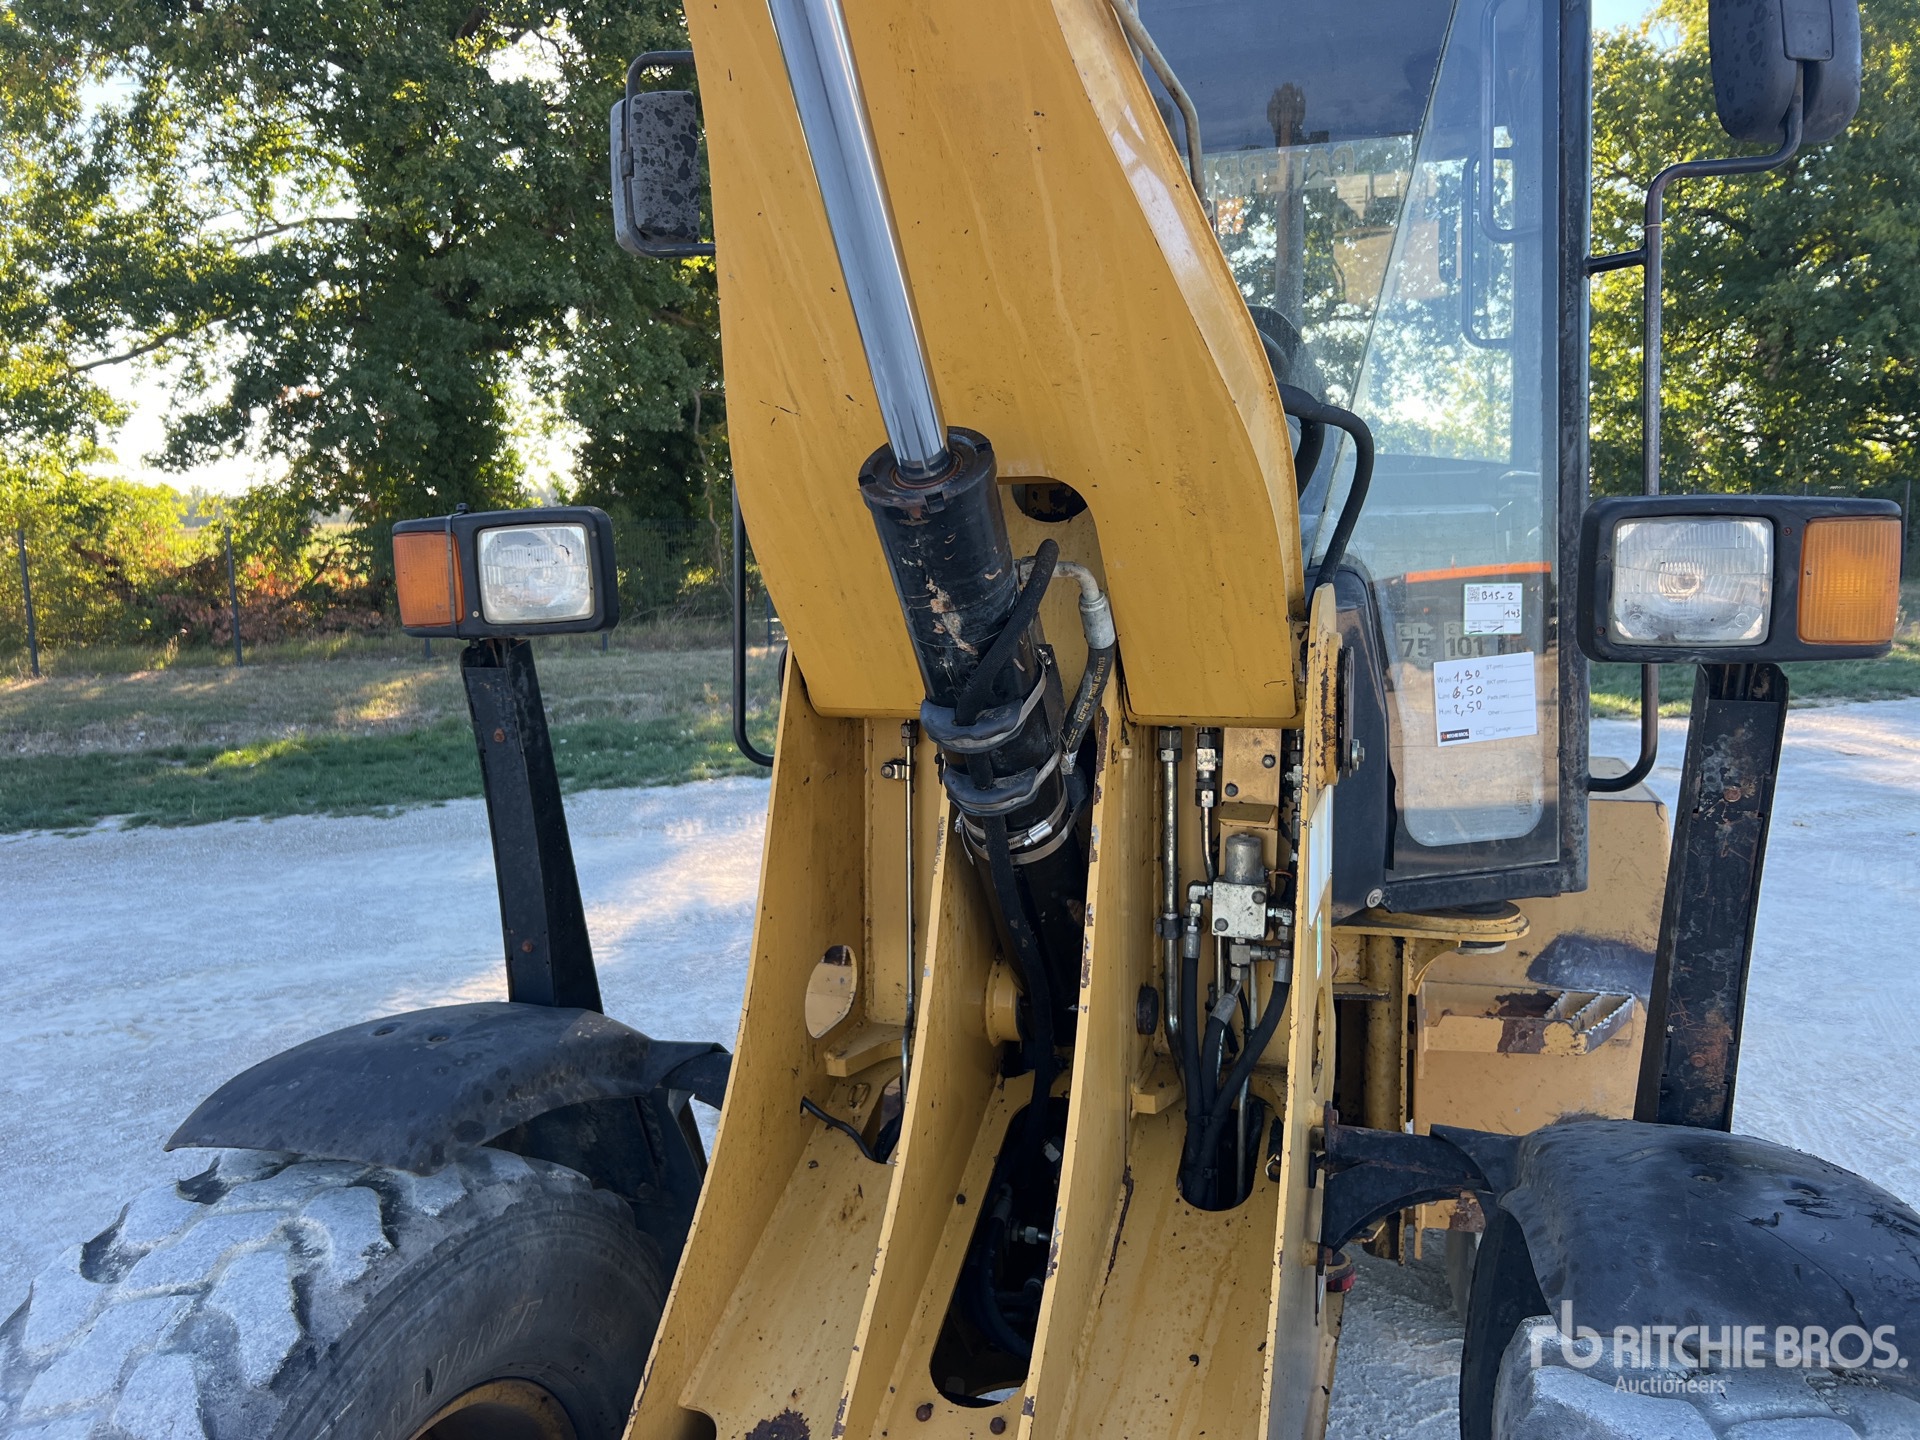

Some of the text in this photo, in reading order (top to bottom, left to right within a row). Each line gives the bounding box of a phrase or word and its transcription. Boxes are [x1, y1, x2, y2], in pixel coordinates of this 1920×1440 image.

[1504, 608, 1521, 619] 143
[1401, 638, 1431, 658] 75
[1445, 636, 1484, 658] 101
